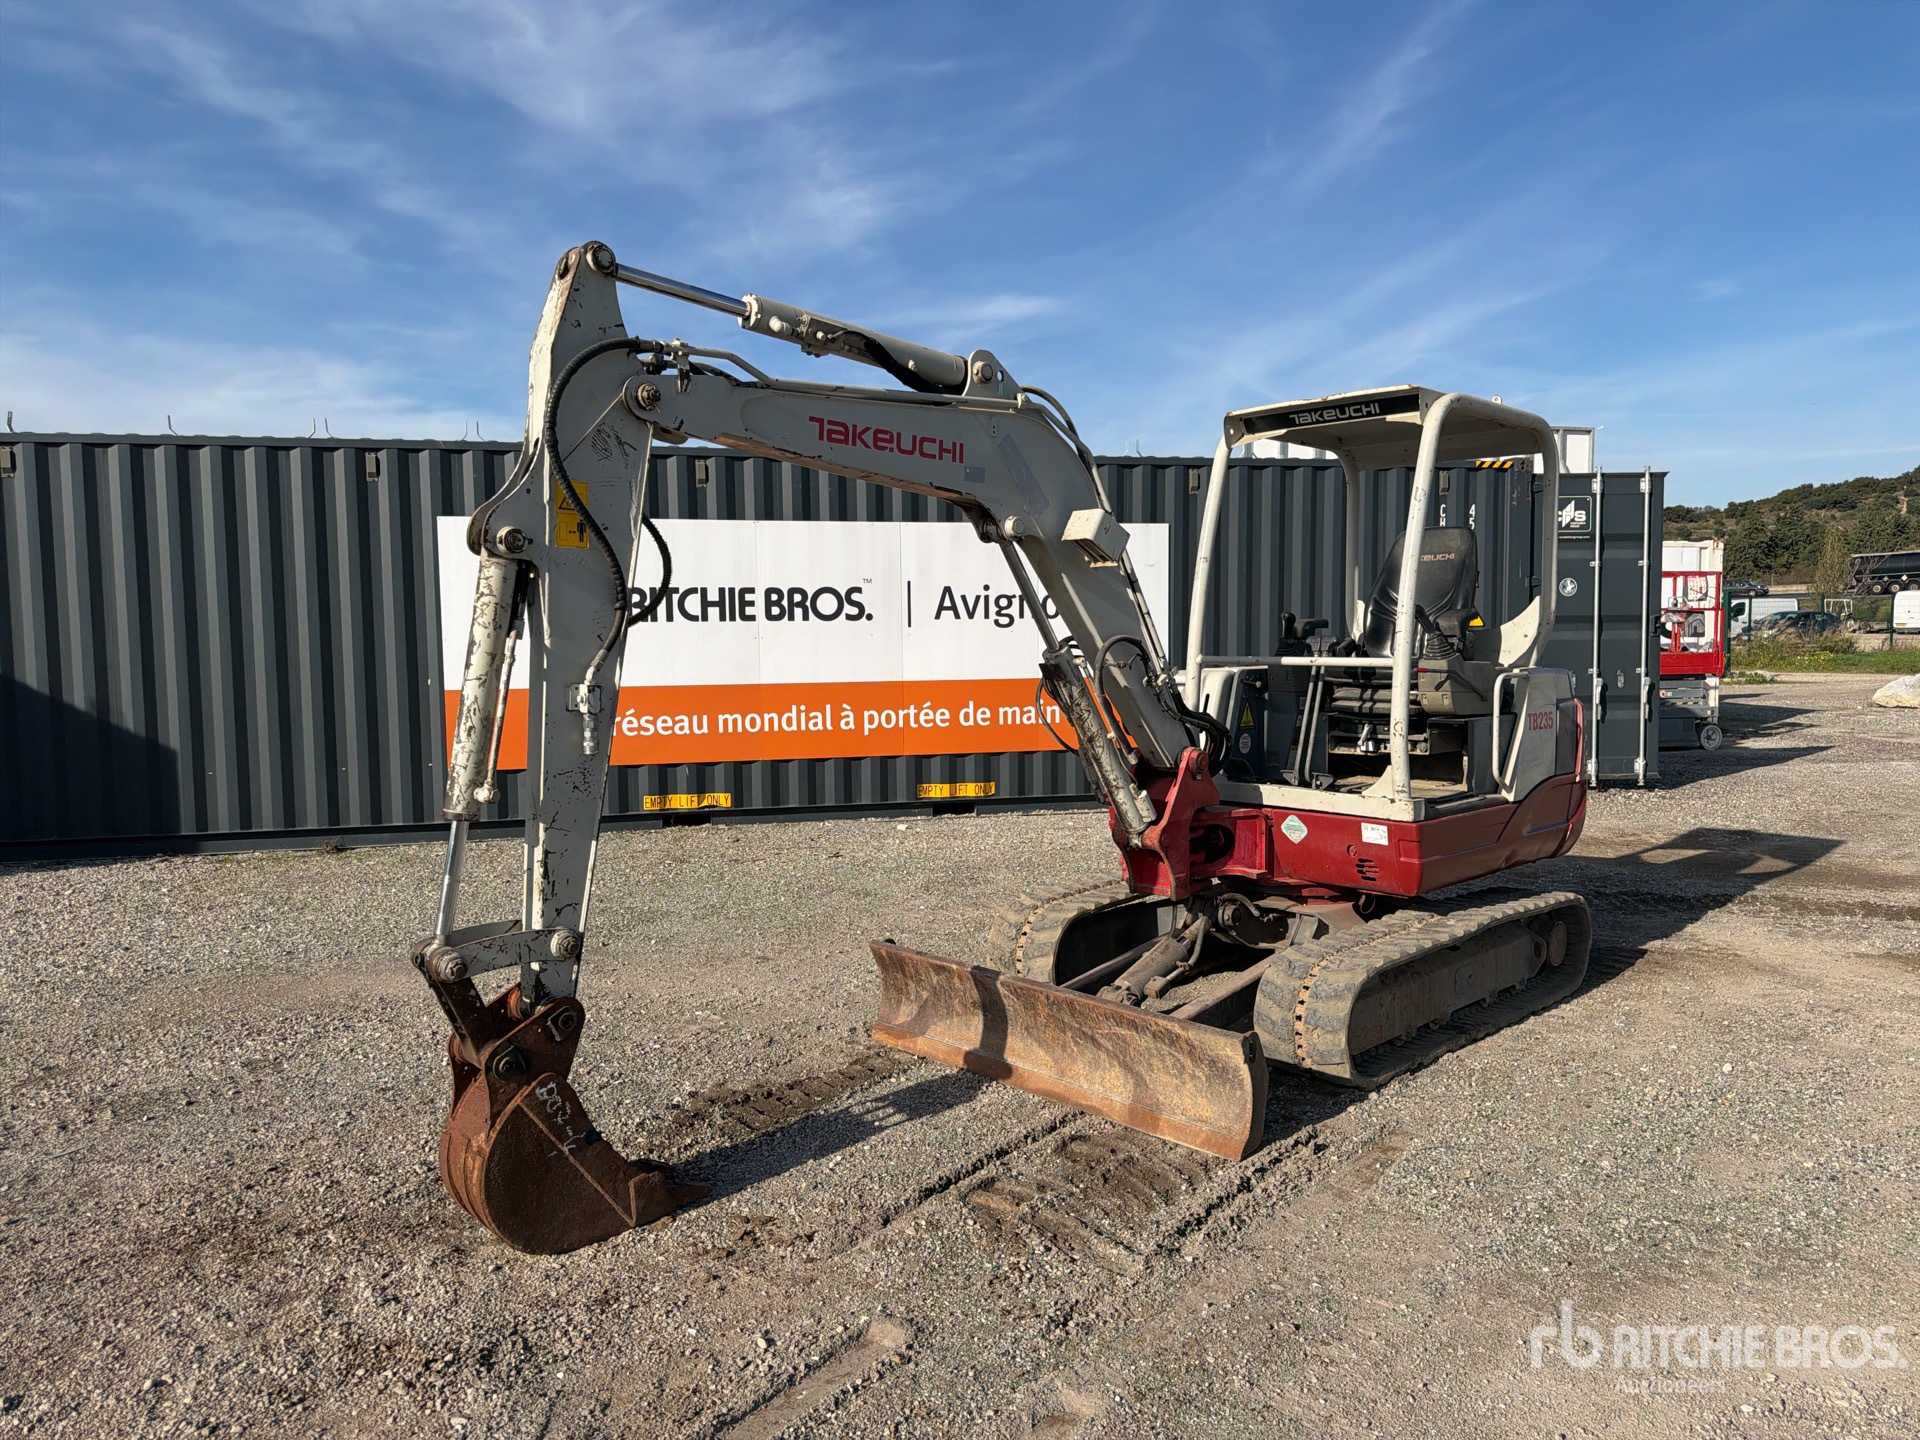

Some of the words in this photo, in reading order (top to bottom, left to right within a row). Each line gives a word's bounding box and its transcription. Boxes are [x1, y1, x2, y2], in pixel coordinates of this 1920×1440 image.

[764, 586, 874, 622] BROS.
[613, 708, 708, 736] réseau
[717, 703, 833, 734] mondial
[840, 702, 856, 730] à
[864, 701, 950, 736] portée
[959, 700, 991, 727] de
[1527, 711, 1554, 731] TB235
[918, 785, 944, 797] EMPTY
[949, 784, 969, 796] LIFT
[974, 783, 994, 795] ONLY
[644, 796, 673, 809] EMPTY
[679, 795, 700, 808] LIFT
[706, 794, 730, 806] ONLY
